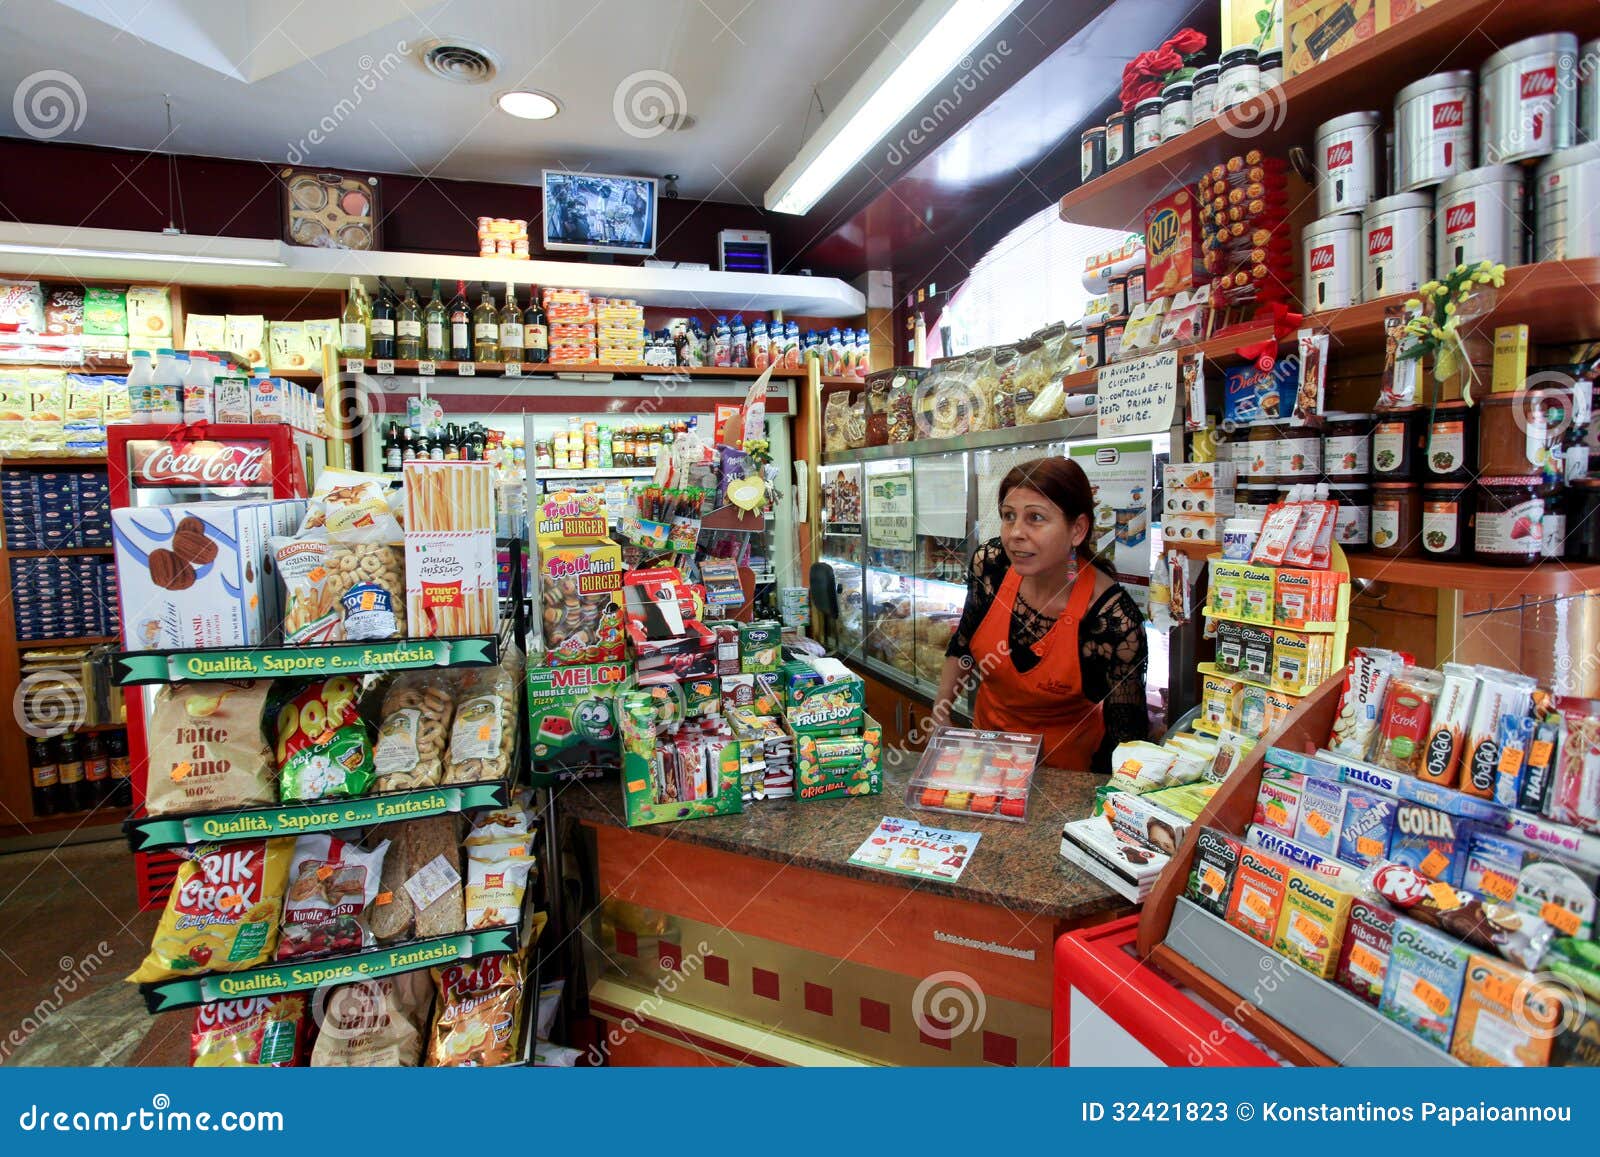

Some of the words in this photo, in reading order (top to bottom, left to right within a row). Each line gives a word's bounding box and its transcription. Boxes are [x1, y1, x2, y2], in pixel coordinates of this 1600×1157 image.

[1434, 104, 1462, 126] illy
[1328, 145, 1351, 166] illy
[1447, 208, 1474, 228] illy
[1152, 213, 1177, 250] RITZ
[1370, 232, 1391, 251] illy
[1311, 249, 1333, 268] illy
[543, 501, 580, 519] Trolli
[539, 519, 563, 534] Mini
[565, 519, 604, 535] BURGER
[286, 555, 321, 566] GRISSINI
[422, 557, 460, 566] Torino
[548, 555, 590, 577] Trolli
[590, 558, 614, 574] Mini
[419, 566, 464, 576] Grissini
[1216, 567, 1240, 577] Ricola
[1243, 570, 1270, 581] Ricola
[1278, 574, 1309, 585] Ricola
[425, 587, 459, 595] CARLO
[581, 575, 620, 592] BURGER
[432, 595, 453, 603] SAN
[1218, 624, 1241, 635] Ricol
[1242, 629, 1270, 643] Ricola
[1276, 636, 1306, 649] Ricola
[188, 655, 257, 675] Qualità,
[263, 653, 325, 673] Sapore
[364, 647, 435, 666] Fantasia
[532, 672, 554, 681] WATER
[1358, 655, 1376, 704] bueno
[532, 688, 566, 698] BUBBLE
[568, 686, 588, 696] GUM
[1205, 682, 1232, 694] Ricola
[176, 727, 228, 745] Fatte
[192, 744, 205, 760] a
[171, 759, 231, 780] ano
[1344, 766, 1393, 791] entos
[184, 785, 215, 798] 100%
[801, 783, 846, 798] ORIGINAL
[1526, 766, 1545, 800] HAL
[1262, 784, 1297, 805] Daygum
[204, 817, 272, 837] Qualità,
[277, 809, 338, 830] Sapore
[377, 796, 446, 816] Fantasia
[1397, 806, 1456, 839] GOLIA
[888, 836, 951, 853] FRULLA
[1199, 834, 1235, 861] Ricola
[203, 849, 256, 885] RIK
[1241, 854, 1283, 882] Ricola
[179, 881, 257, 915] CROK
[1289, 878, 1335, 909] Ricola
[1352, 924, 1377, 945] Ribes
[1397, 931, 1458, 970] Ricola
[220, 971, 287, 993] Qualità,
[292, 966, 352, 986] Sapore
[390, 943, 458, 967] Fantasia
